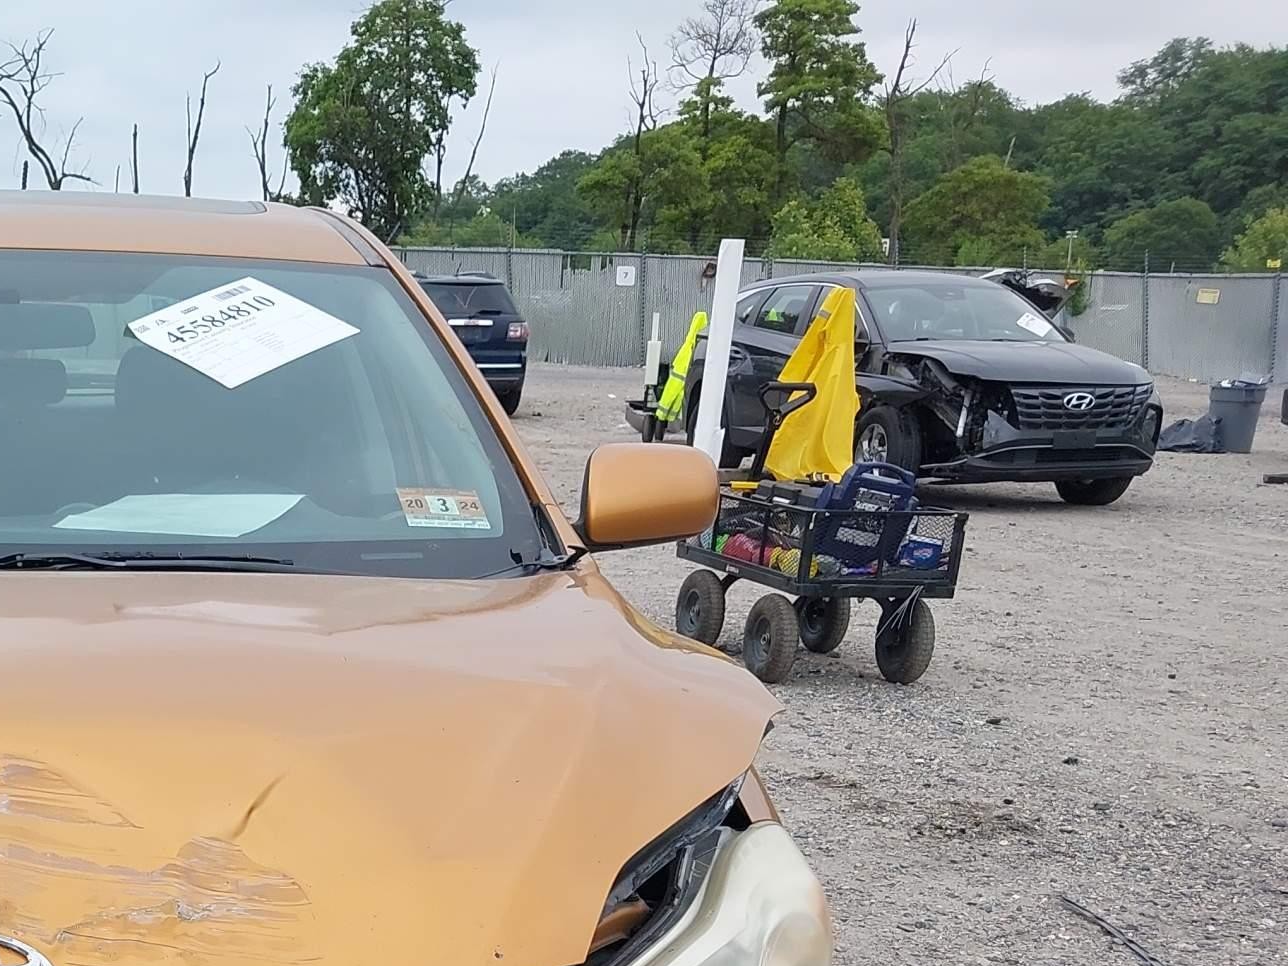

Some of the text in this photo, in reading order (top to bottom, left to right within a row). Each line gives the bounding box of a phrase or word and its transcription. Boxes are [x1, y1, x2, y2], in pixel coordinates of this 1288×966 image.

[623, 271, 629, 279] 7
[168, 295, 276, 344] 45584810
[405, 498, 479, 513] 20 3 24
